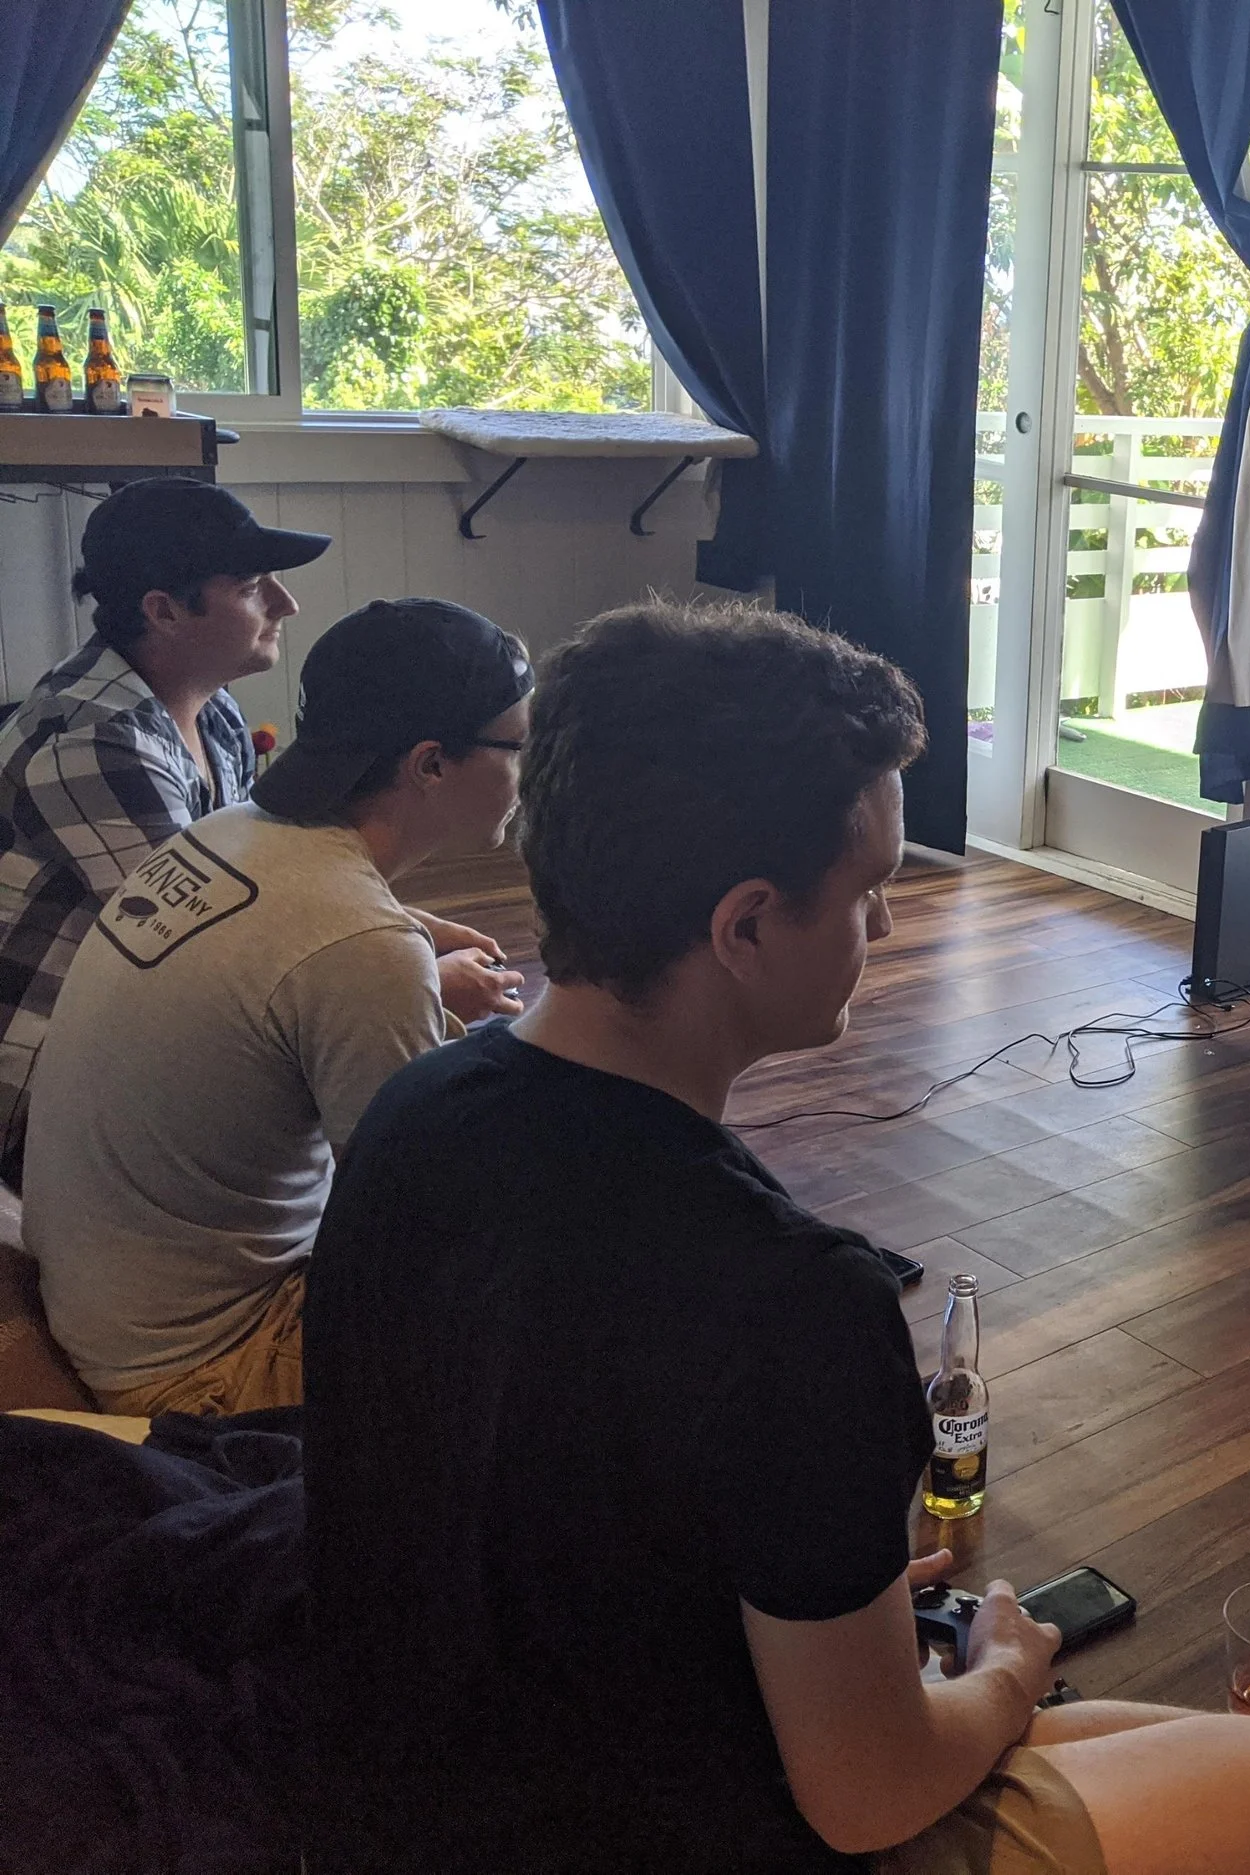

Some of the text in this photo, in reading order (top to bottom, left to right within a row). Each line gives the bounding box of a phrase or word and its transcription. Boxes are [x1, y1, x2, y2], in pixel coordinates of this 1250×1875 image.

[185, 896, 212, 917] NY
[938, 1411, 989, 1437] Corona
[954, 1430, 983, 1444] Extra
